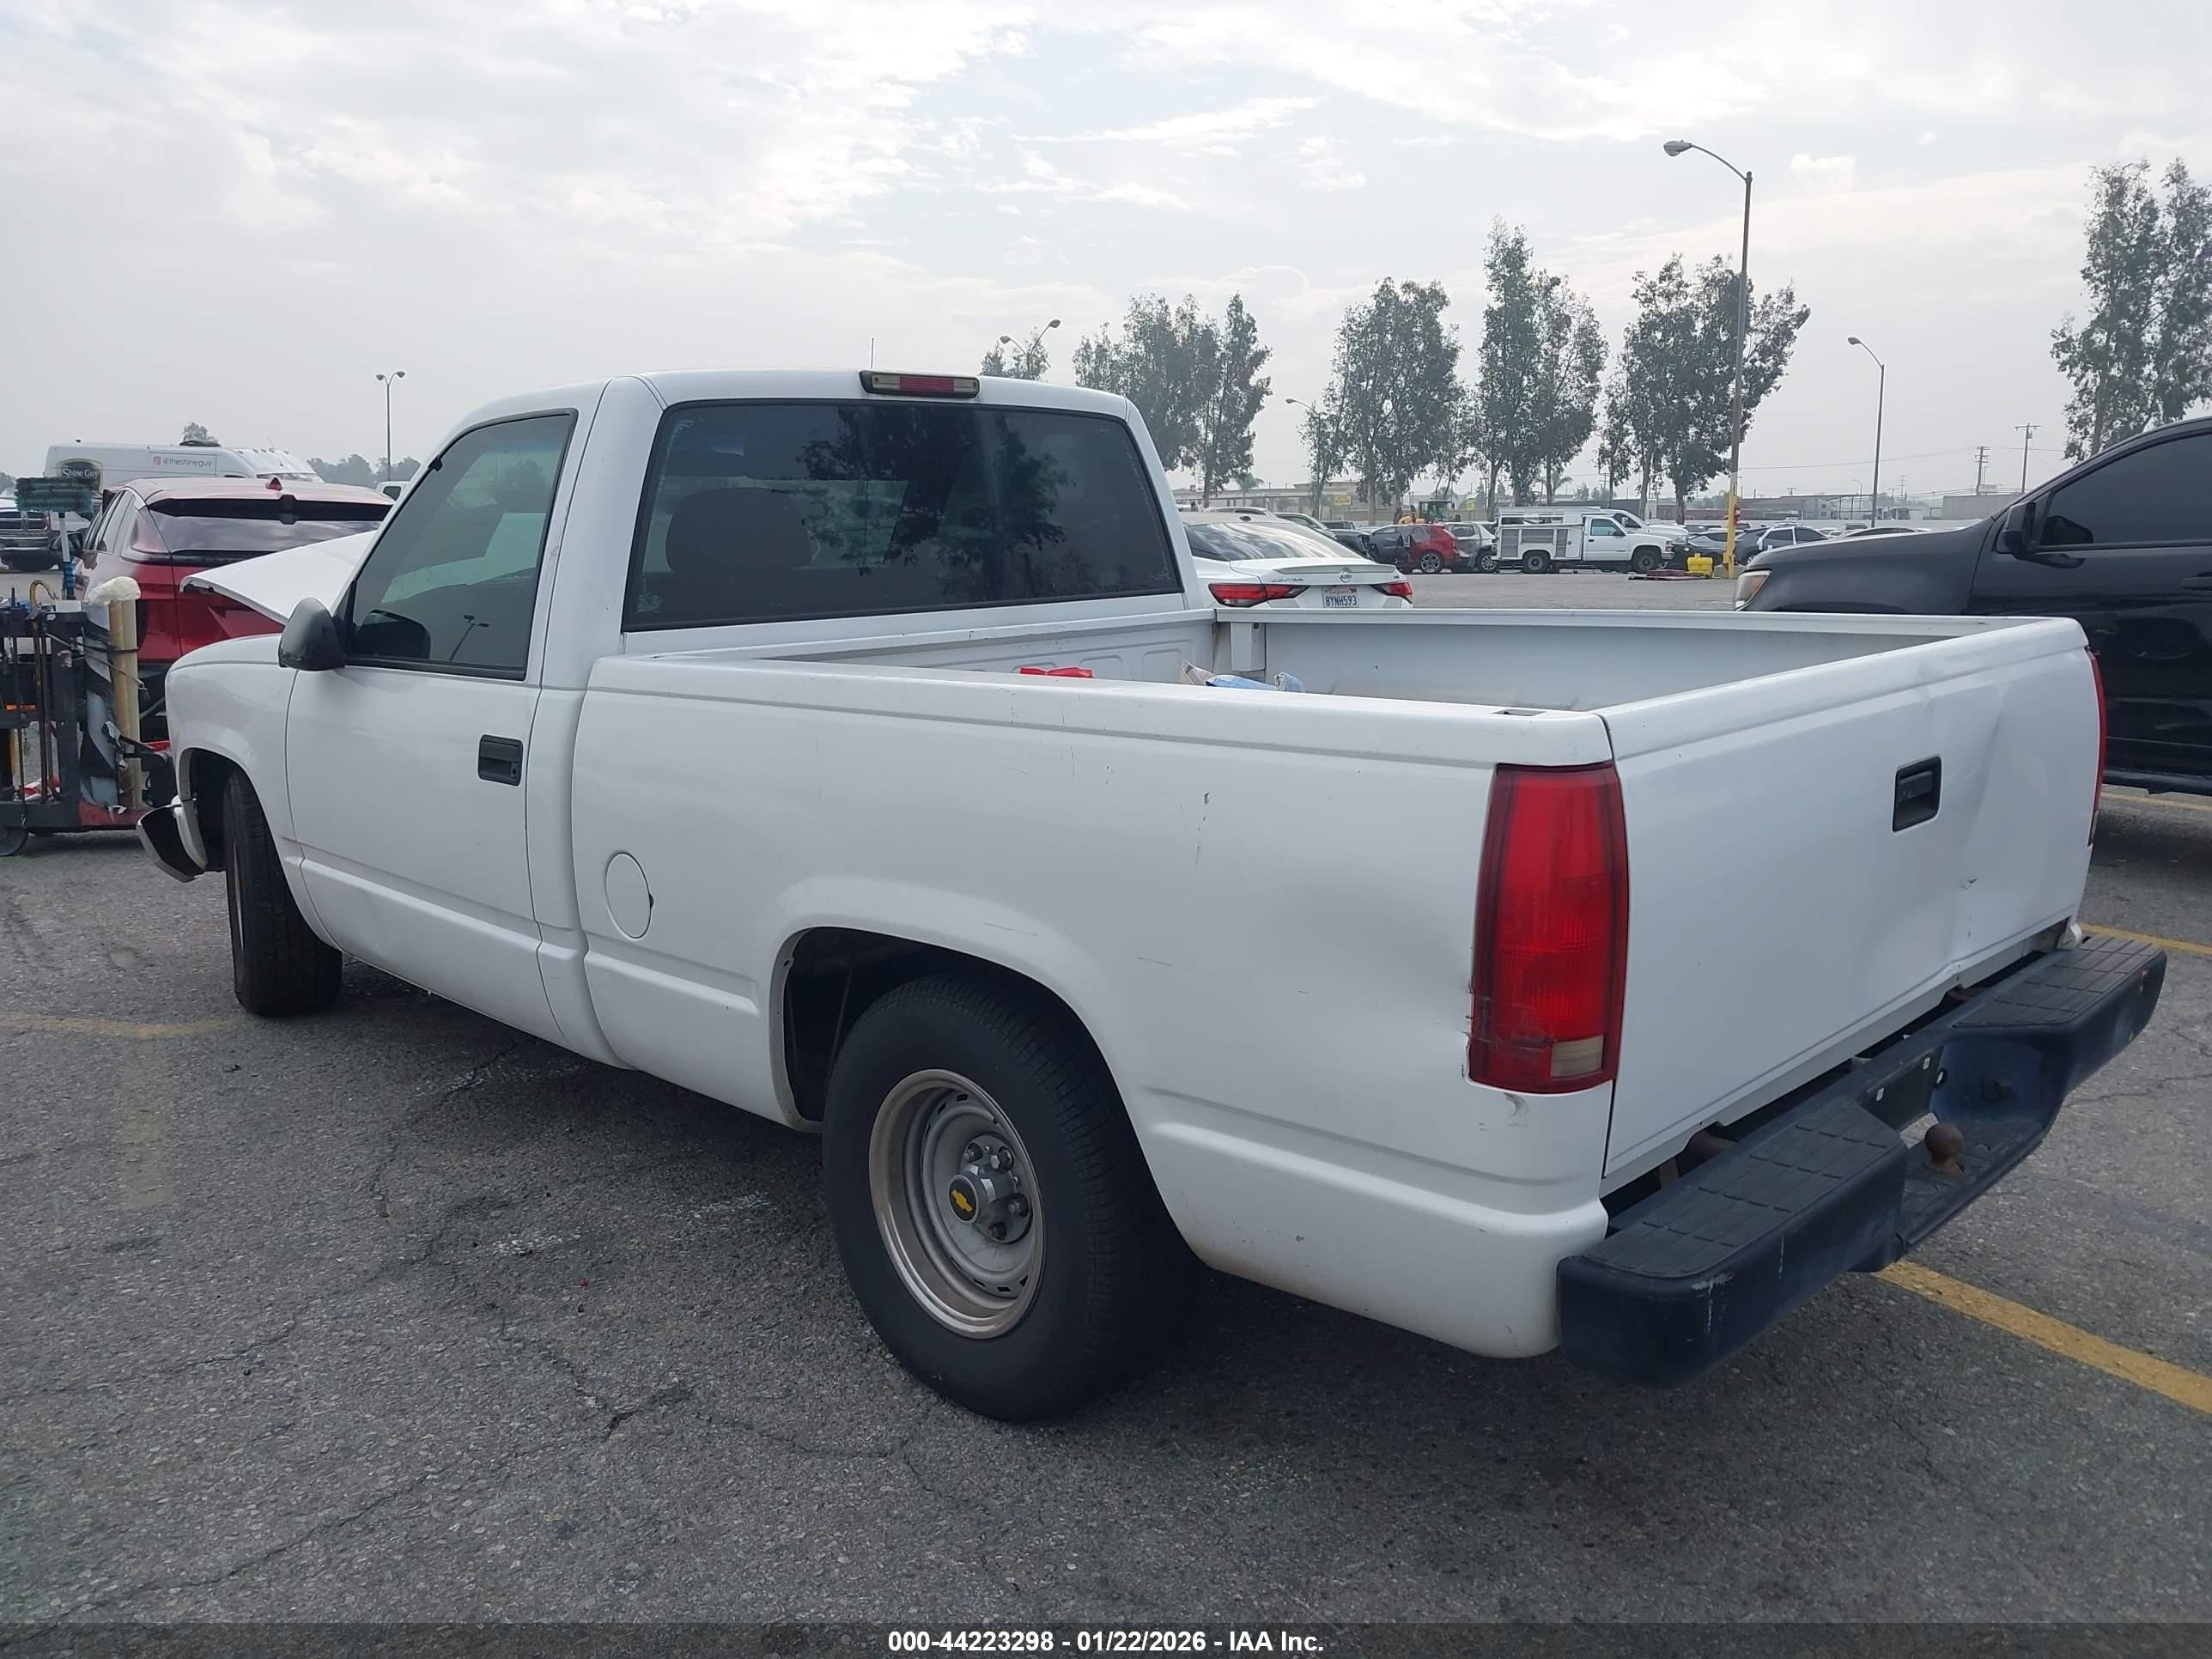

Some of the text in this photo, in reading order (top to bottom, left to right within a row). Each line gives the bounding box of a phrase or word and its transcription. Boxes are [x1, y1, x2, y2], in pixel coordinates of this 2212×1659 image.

[163, 457, 212, 467] @theshineguy
[62, 468, 98, 479] Shine Guy
[1325, 595, 1358, 607] 8YNH593
